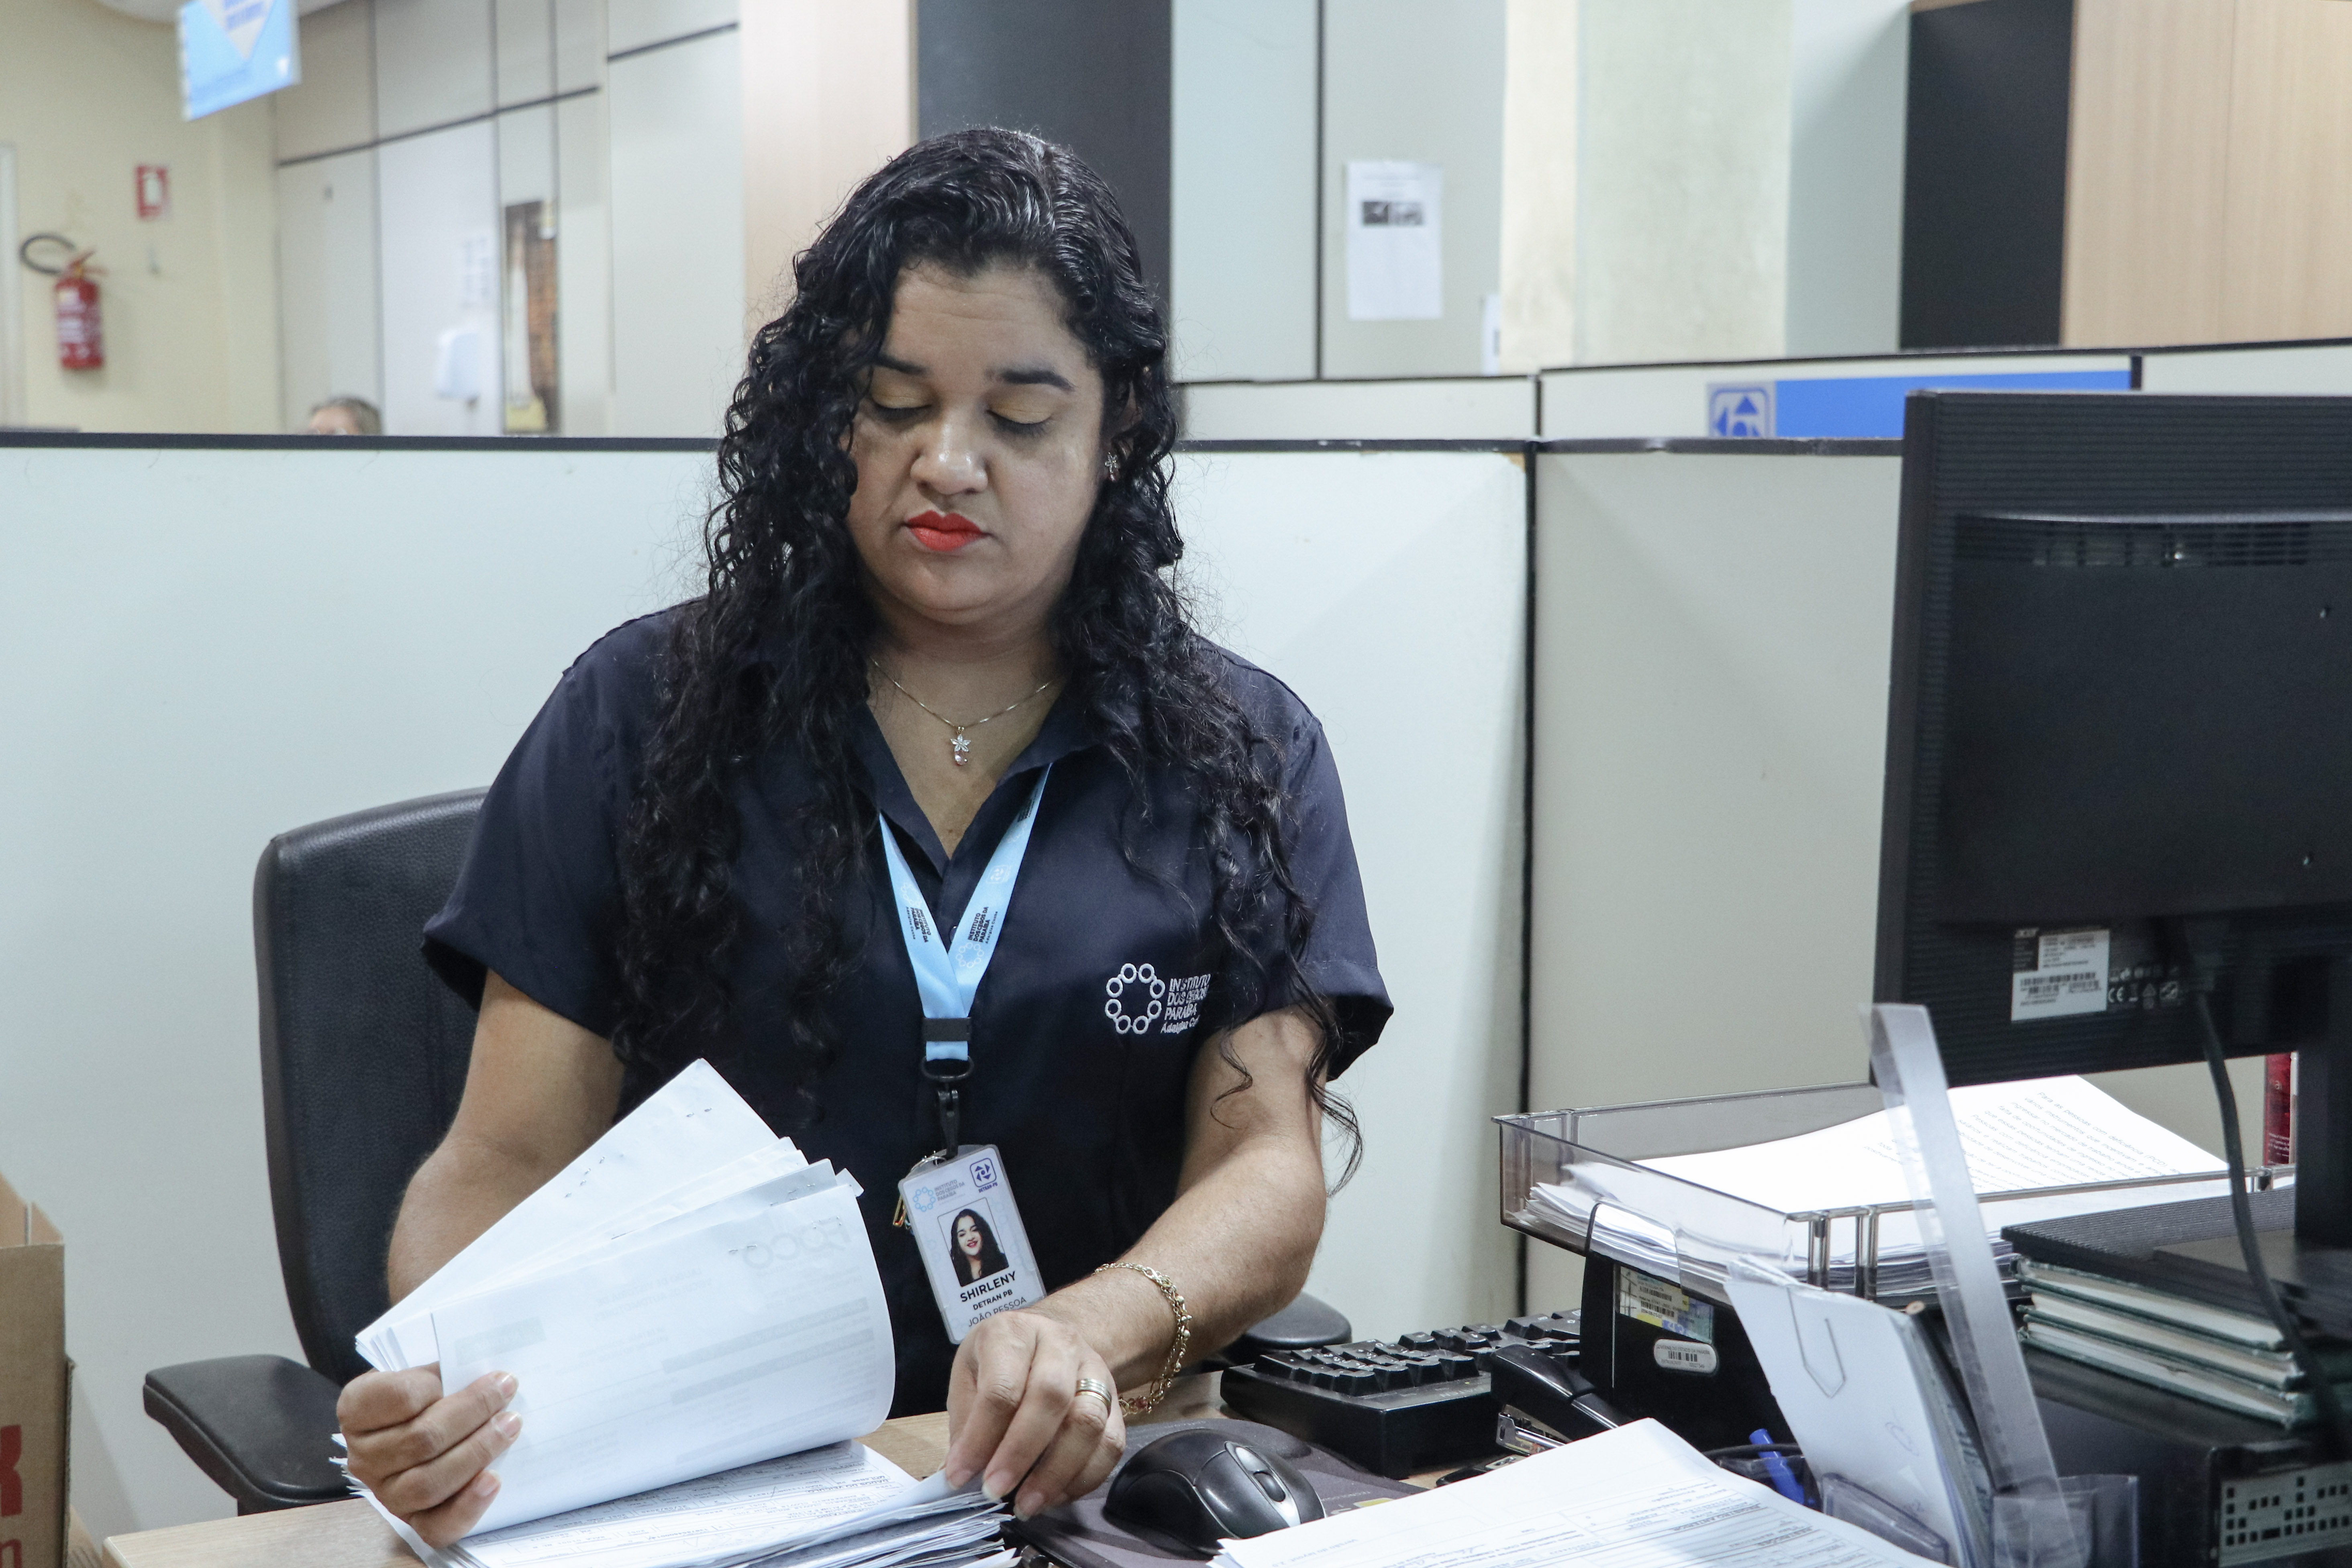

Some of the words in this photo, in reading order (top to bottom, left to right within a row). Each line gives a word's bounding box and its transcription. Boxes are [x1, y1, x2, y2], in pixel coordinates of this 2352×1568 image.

[918, 909, 931, 935] INSTITUTO
[967, 913, 981, 940] INSTITUTO
[977, 914, 986, 930] CEGOS
[1169, 973, 1211, 992] INSTITUTO
[2037, 1092, 2053, 1103] Para
[2062, 1109, 2091, 1126] pessoas
[2092, 1127, 2107, 1135] com
[1970, 1114, 1998, 1132] Pessoas
[1999, 1132, 2013, 1140] com
[1985, 1110, 1997, 1118] que
[1998, 1118, 2017, 1130] essas
[2015, 1130, 2043, 1146] pessoas
[2044, 1145, 2069, 1158] tenham
[1998, 1106, 2012, 1115] falta
[2022, 1121, 2066, 1146] oportunidades
[2077, 1152, 2105, 1166] ingresso
[2045, 1111, 2085, 1134] instrumentos
[2101, 1143, 2136, 1162] incentivam
[2050, 1126, 2077, 1142] mercado
[2088, 1147, 2114, 1161] trabalho
[2115, 1161, 2134, 1170] ainda
[934, 1179, 957, 1191] INSTITUTO
[978, 1182, 998, 1193] DETRAN-PB
[960, 1270, 1016, 1303] SHIRLENY
[973, 1293, 1002, 1310] DETRAN
[1003, 1289, 1013, 1297] PB
[969, 1311, 992, 1327] JOÃO
